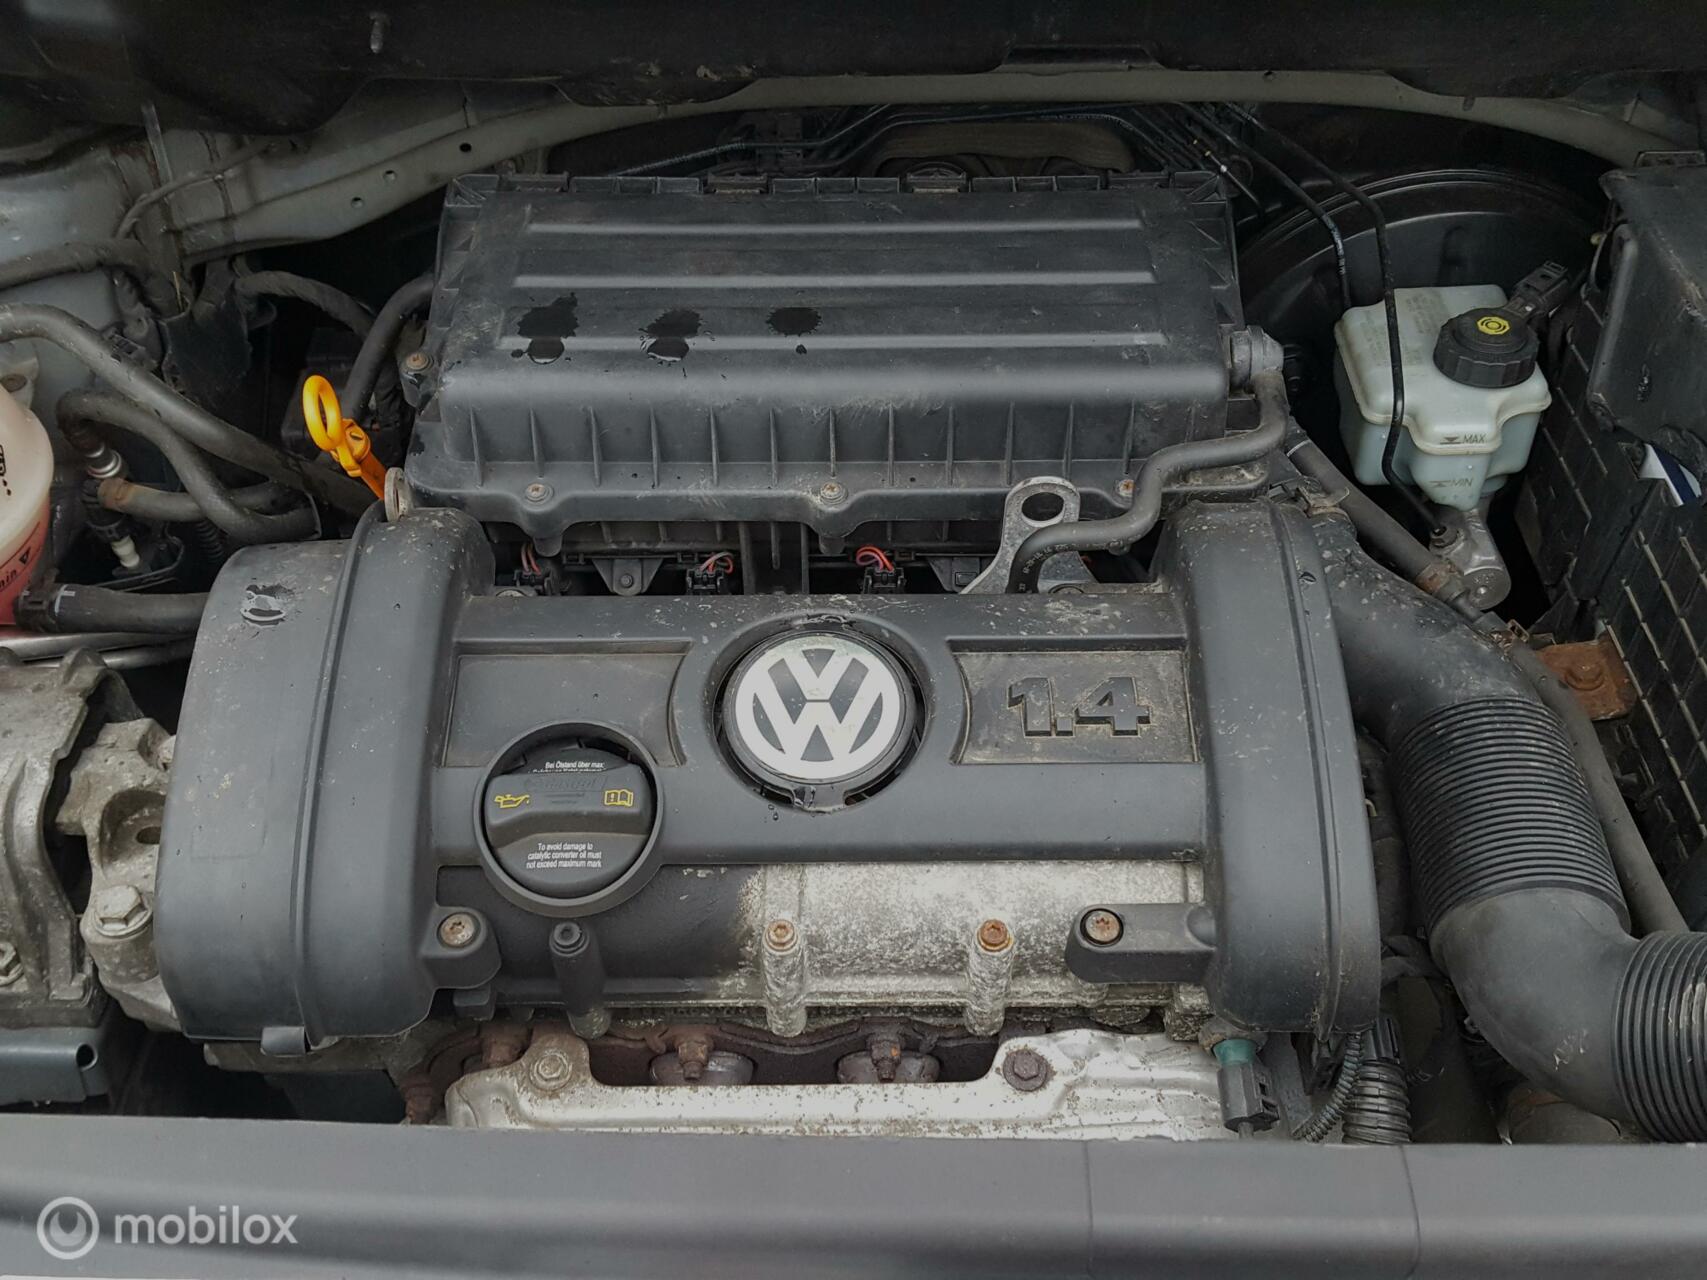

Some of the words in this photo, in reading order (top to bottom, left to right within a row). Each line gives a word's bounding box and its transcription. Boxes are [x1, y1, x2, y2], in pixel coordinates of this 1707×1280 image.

[1463, 433, 1486, 444] MAX
[1451, 478, 1473, 487] MIN
[1008, 676, 1151, 737] 1.4
[545, 761, 555, 769] Bei
[538, 842, 546, 851] To
[546, 842, 562, 851] avoid
[562, 842, 586, 852] damage
[587, 842, 594, 850] to
[527, 851, 552, 861] catalytic
[551, 851, 579, 859] converter
[579, 850, 587, 859] oil
[587, 851, 602, 859] must
[526, 860, 536, 869] not
[536, 860, 558, 868] exceed
[558, 859, 586, 869] maximum
[586, 860, 602, 868] mark
